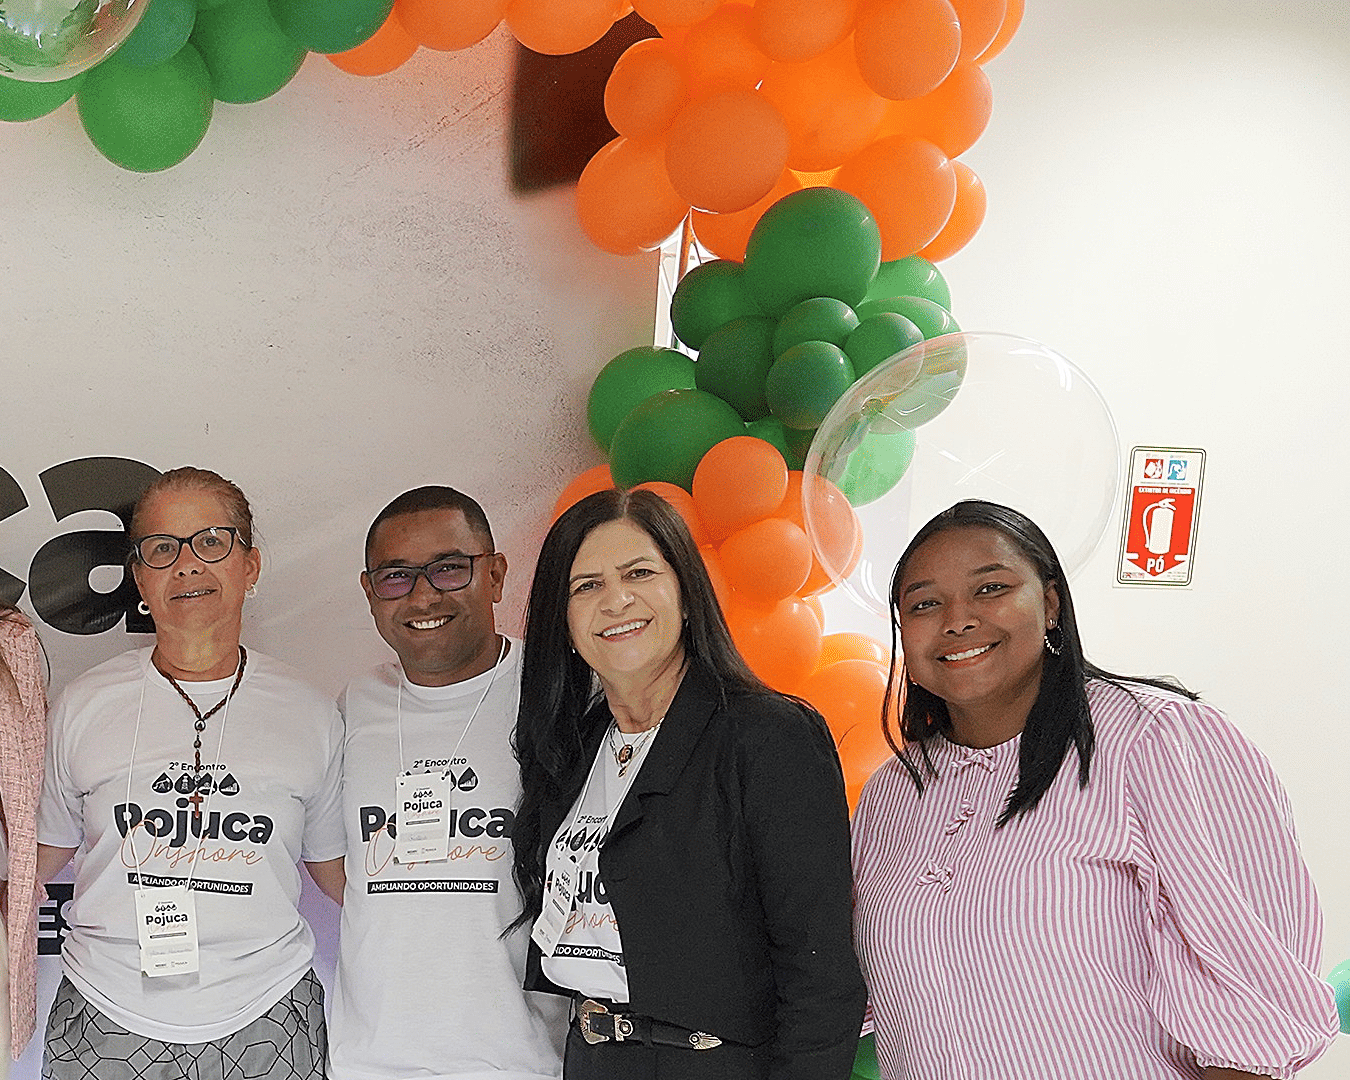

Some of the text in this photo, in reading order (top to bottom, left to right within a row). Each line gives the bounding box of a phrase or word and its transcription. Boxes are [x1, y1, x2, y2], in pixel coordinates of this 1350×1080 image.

[1146, 555, 1165, 573] PÓ
[181, 763, 226, 771] Enontro
[403, 799, 442, 813] Pojuca
[114, 797, 274, 848] Pojuca
[121, 818, 263, 869] Onshore
[371, 881, 494, 892] AMPLIANDO OPORTUNIDADES
[145, 913, 188, 926] Pojuca
